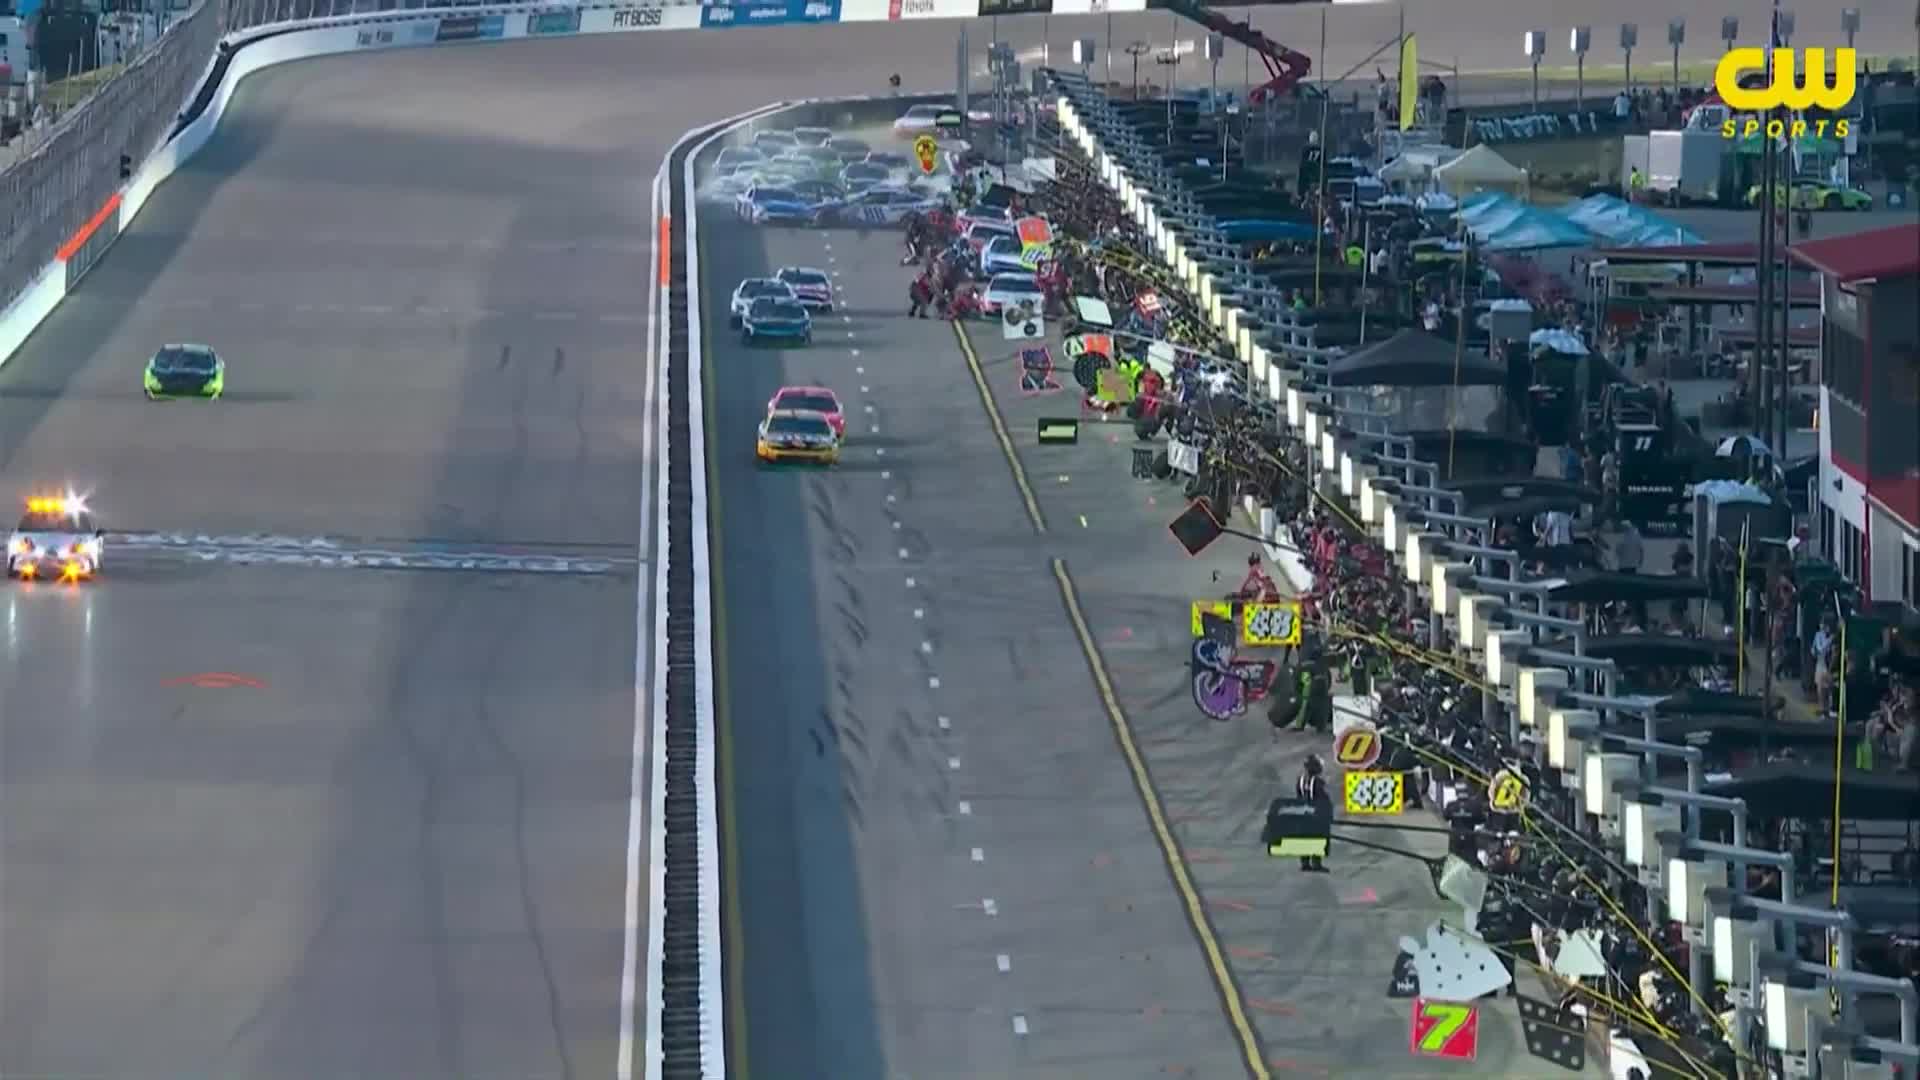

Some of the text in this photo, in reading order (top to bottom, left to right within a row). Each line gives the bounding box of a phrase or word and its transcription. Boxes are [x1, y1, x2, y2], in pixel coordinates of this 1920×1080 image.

[1248, 606, 1295, 640] 48
[1351, 776, 1395, 808] 48
[1419, 1002, 1473, 1053] 7
